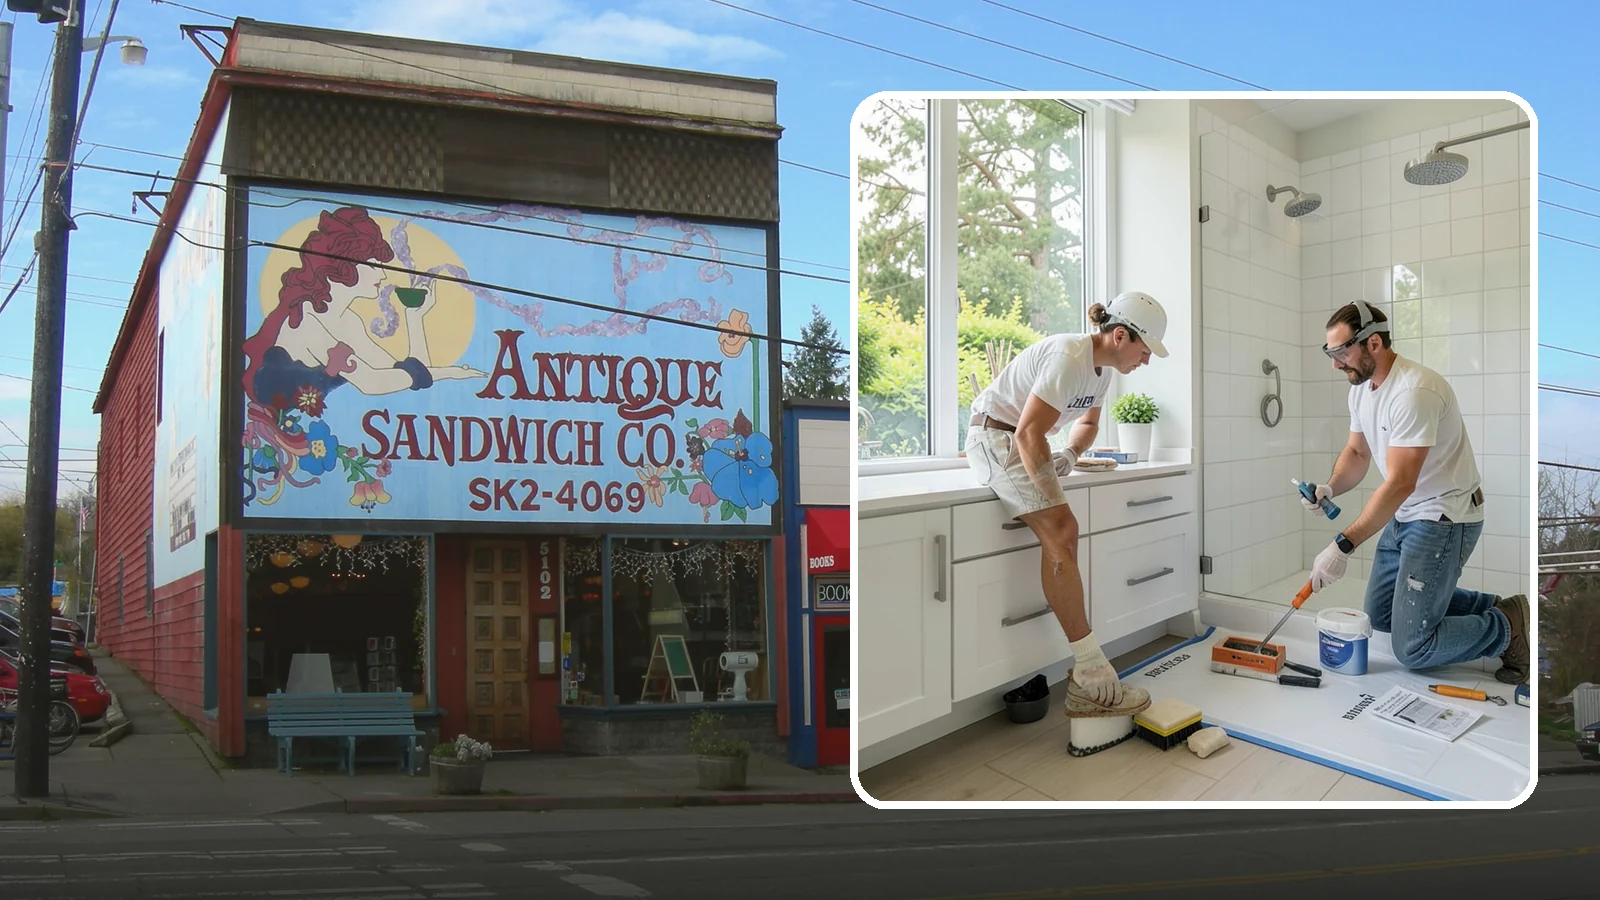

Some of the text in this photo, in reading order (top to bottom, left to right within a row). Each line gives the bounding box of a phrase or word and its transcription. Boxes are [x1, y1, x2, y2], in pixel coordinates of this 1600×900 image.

[475, 329, 724, 421] ANTIQUE
[362, 409, 686, 467] SANDWICH CO.
[468, 477, 646, 513] SK2-4069
[540, 541, 551, 600] 5102
[809, 555, 835, 569] BOOKS
